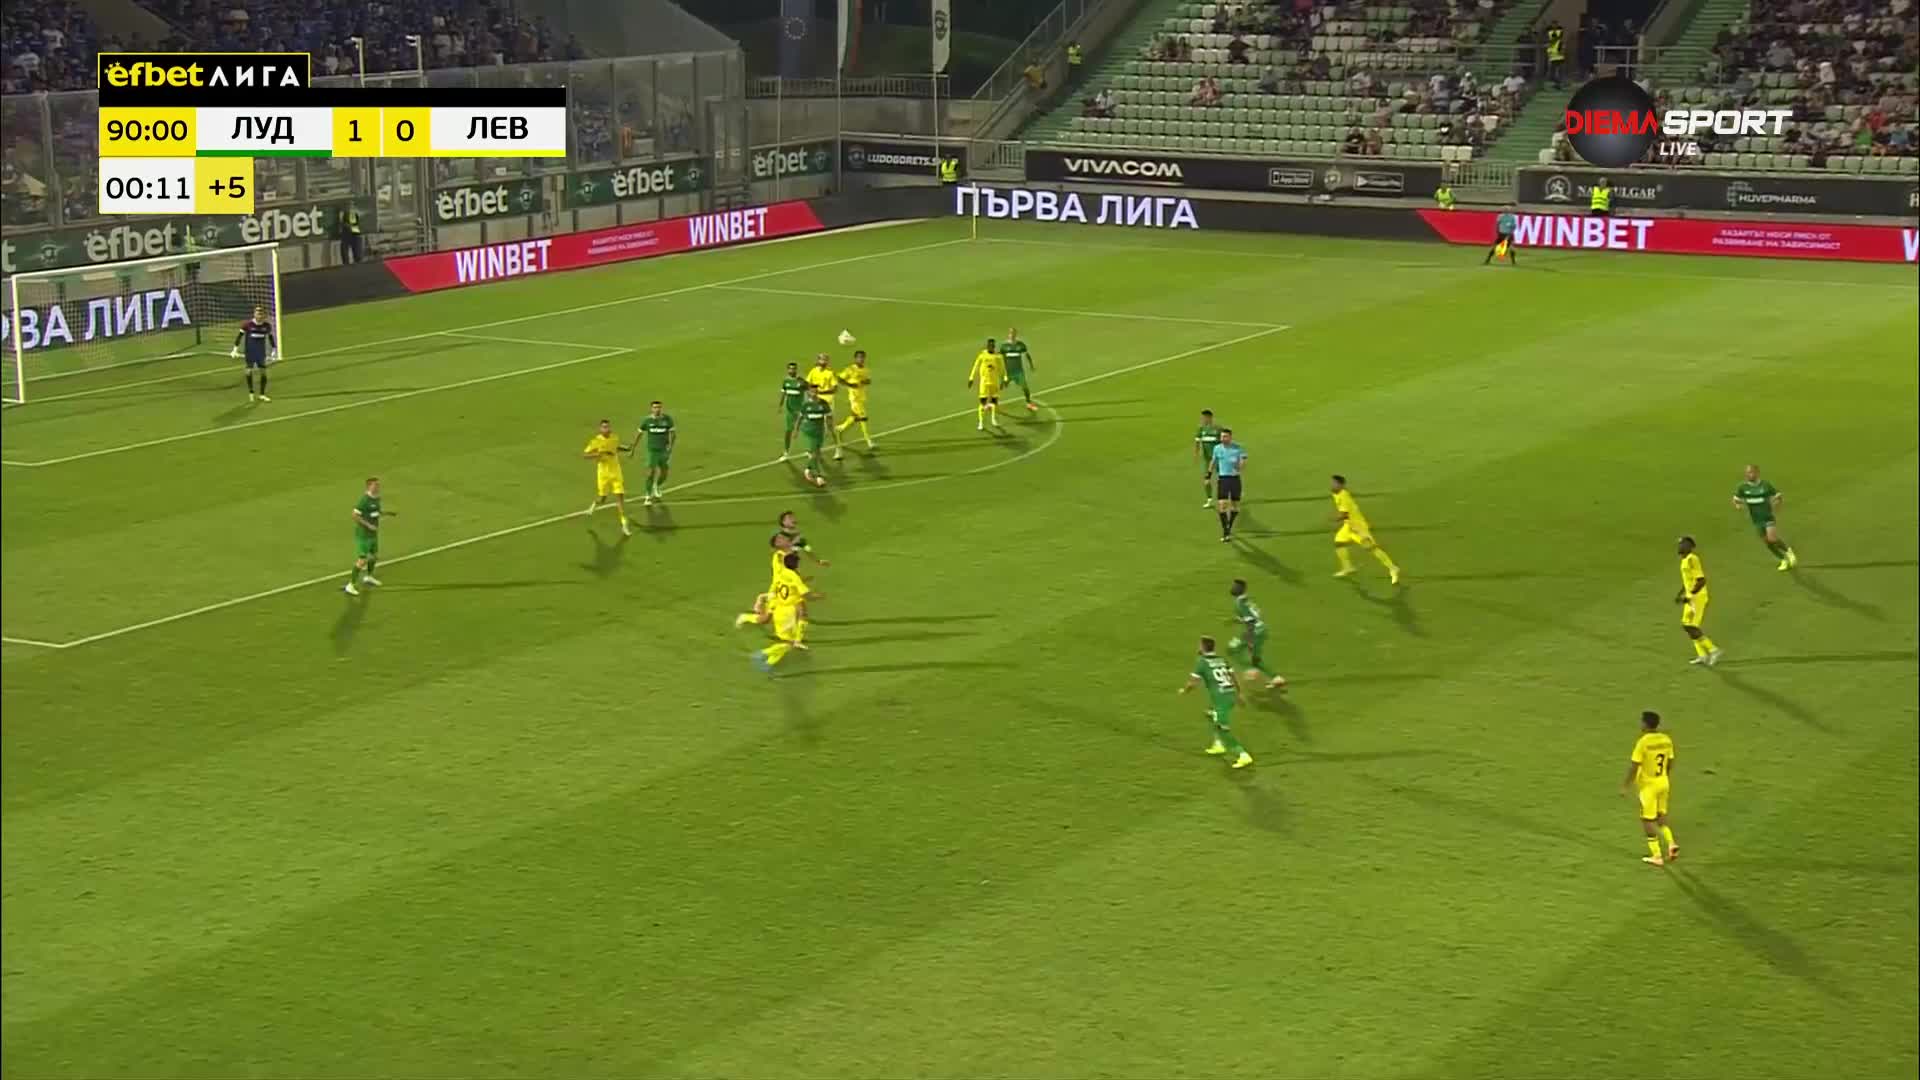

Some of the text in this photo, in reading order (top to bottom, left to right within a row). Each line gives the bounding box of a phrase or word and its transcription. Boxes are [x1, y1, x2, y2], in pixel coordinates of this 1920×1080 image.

[1063, 158, 1184, 178] VIVACOM
[689, 207, 769, 248] WINBET
[956, 186, 1200, 230] ПЪРВА ЛИГА
[1513, 214, 1655, 250] WINBET
[455, 239, 553, 284] WINBET
[2, 288, 192, 350] ВА ЛИГА
